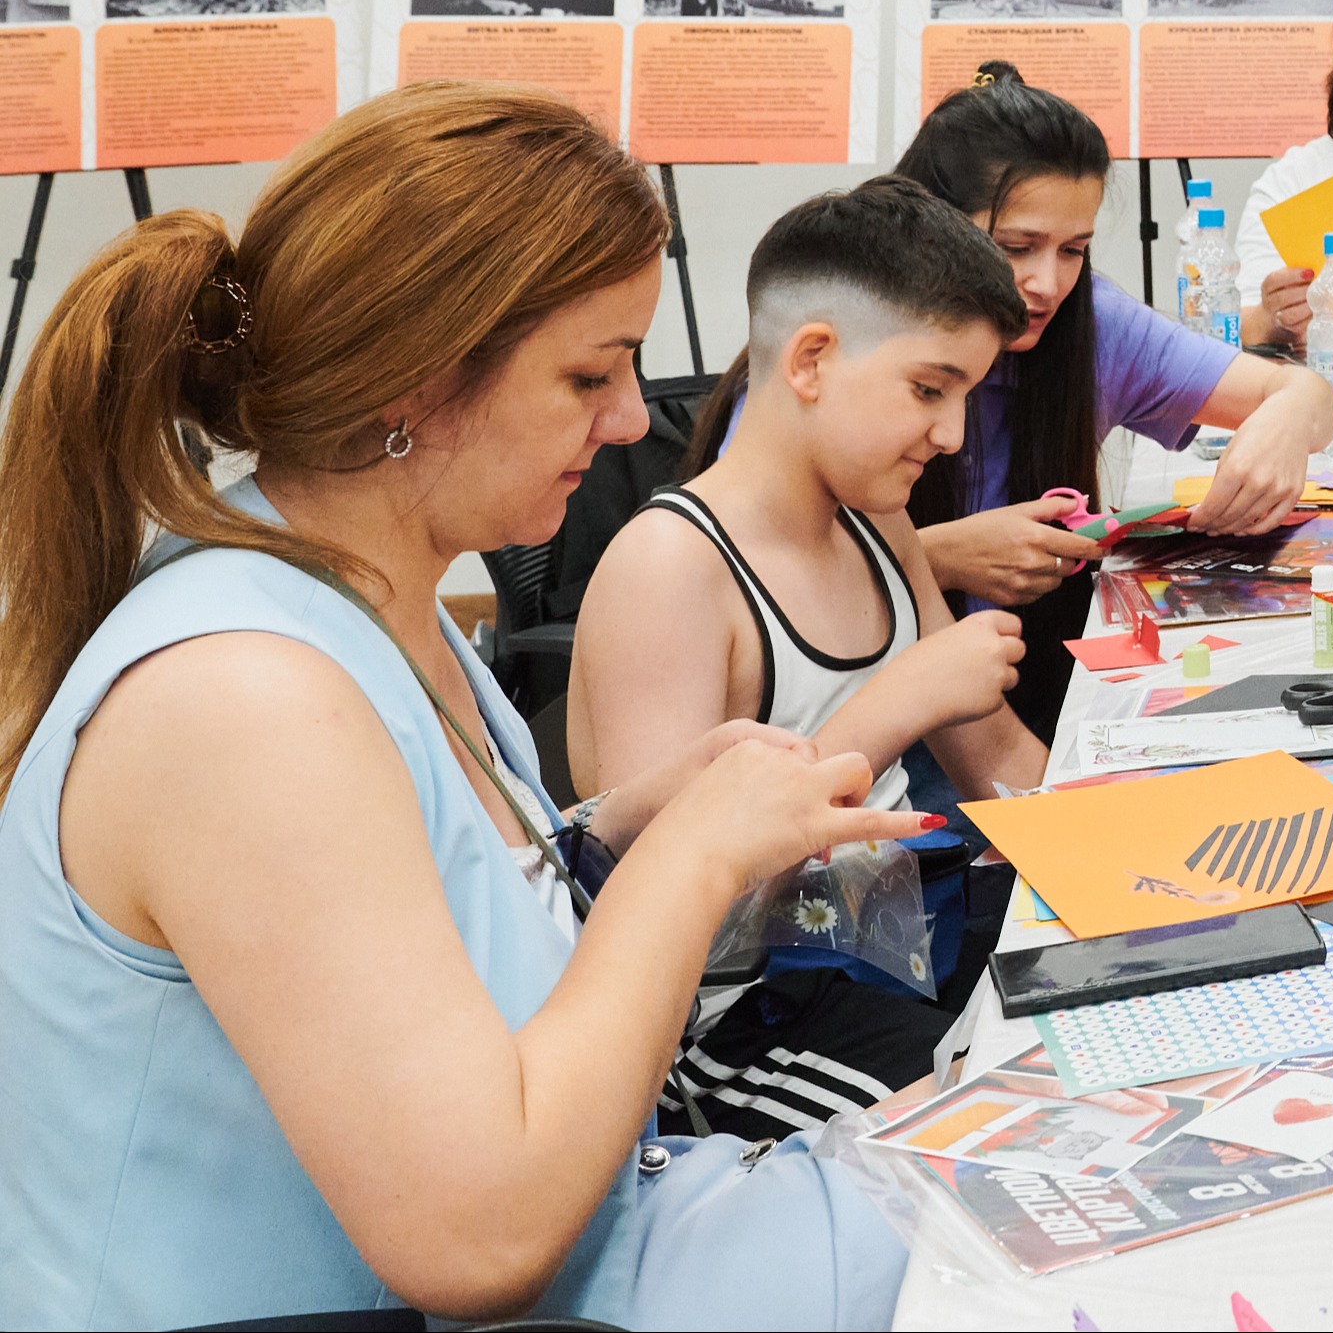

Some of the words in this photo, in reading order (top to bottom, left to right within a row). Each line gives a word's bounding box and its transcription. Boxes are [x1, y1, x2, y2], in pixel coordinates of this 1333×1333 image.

[1227, 317, 1238, 346] rgol
[1268, 1161, 1327, 1179] 8
[1053, 1176, 1147, 1233] КАРТО
[1188, 1182, 1248, 1201] 8
[984, 1169, 1101, 1246] ЦВЕТНОЙ
